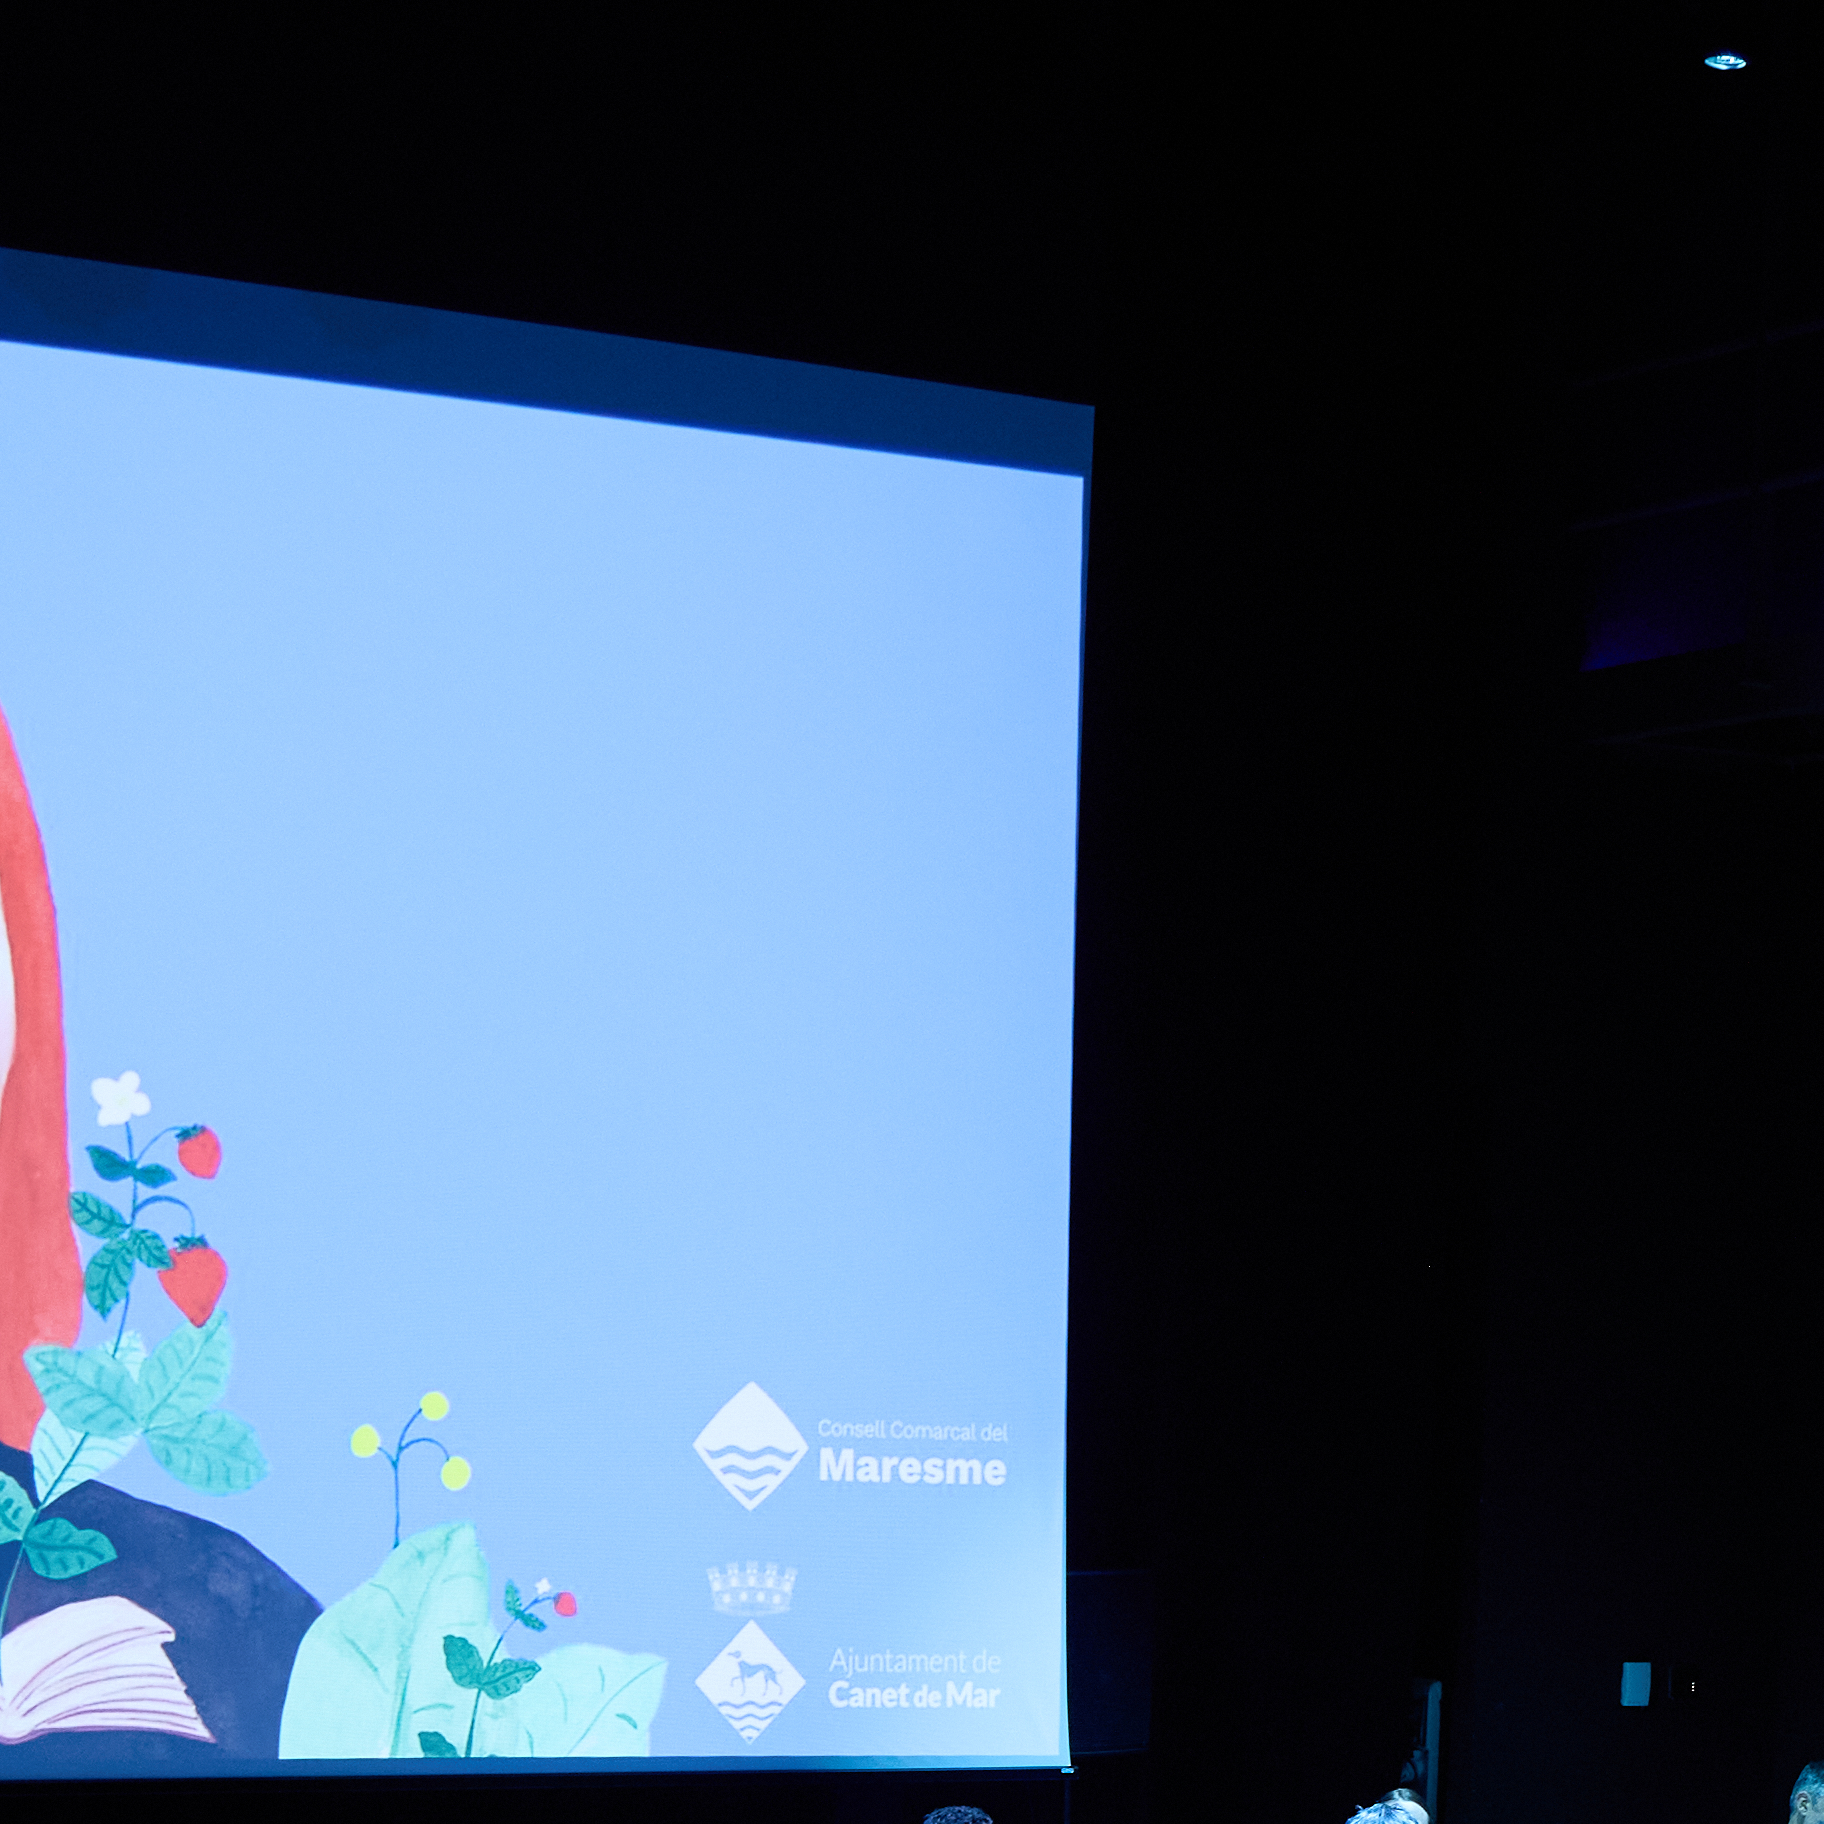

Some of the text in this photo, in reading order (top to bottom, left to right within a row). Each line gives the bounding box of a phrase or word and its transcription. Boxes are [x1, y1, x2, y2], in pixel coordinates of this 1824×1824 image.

[818, 1418, 1008, 1442] Consell Comarcal del
[819, 1447, 1007, 1486] Maresme
[829, 1647, 1001, 1678] Ajuntament de
[828, 1680, 1001, 1708] Canet de Mar
